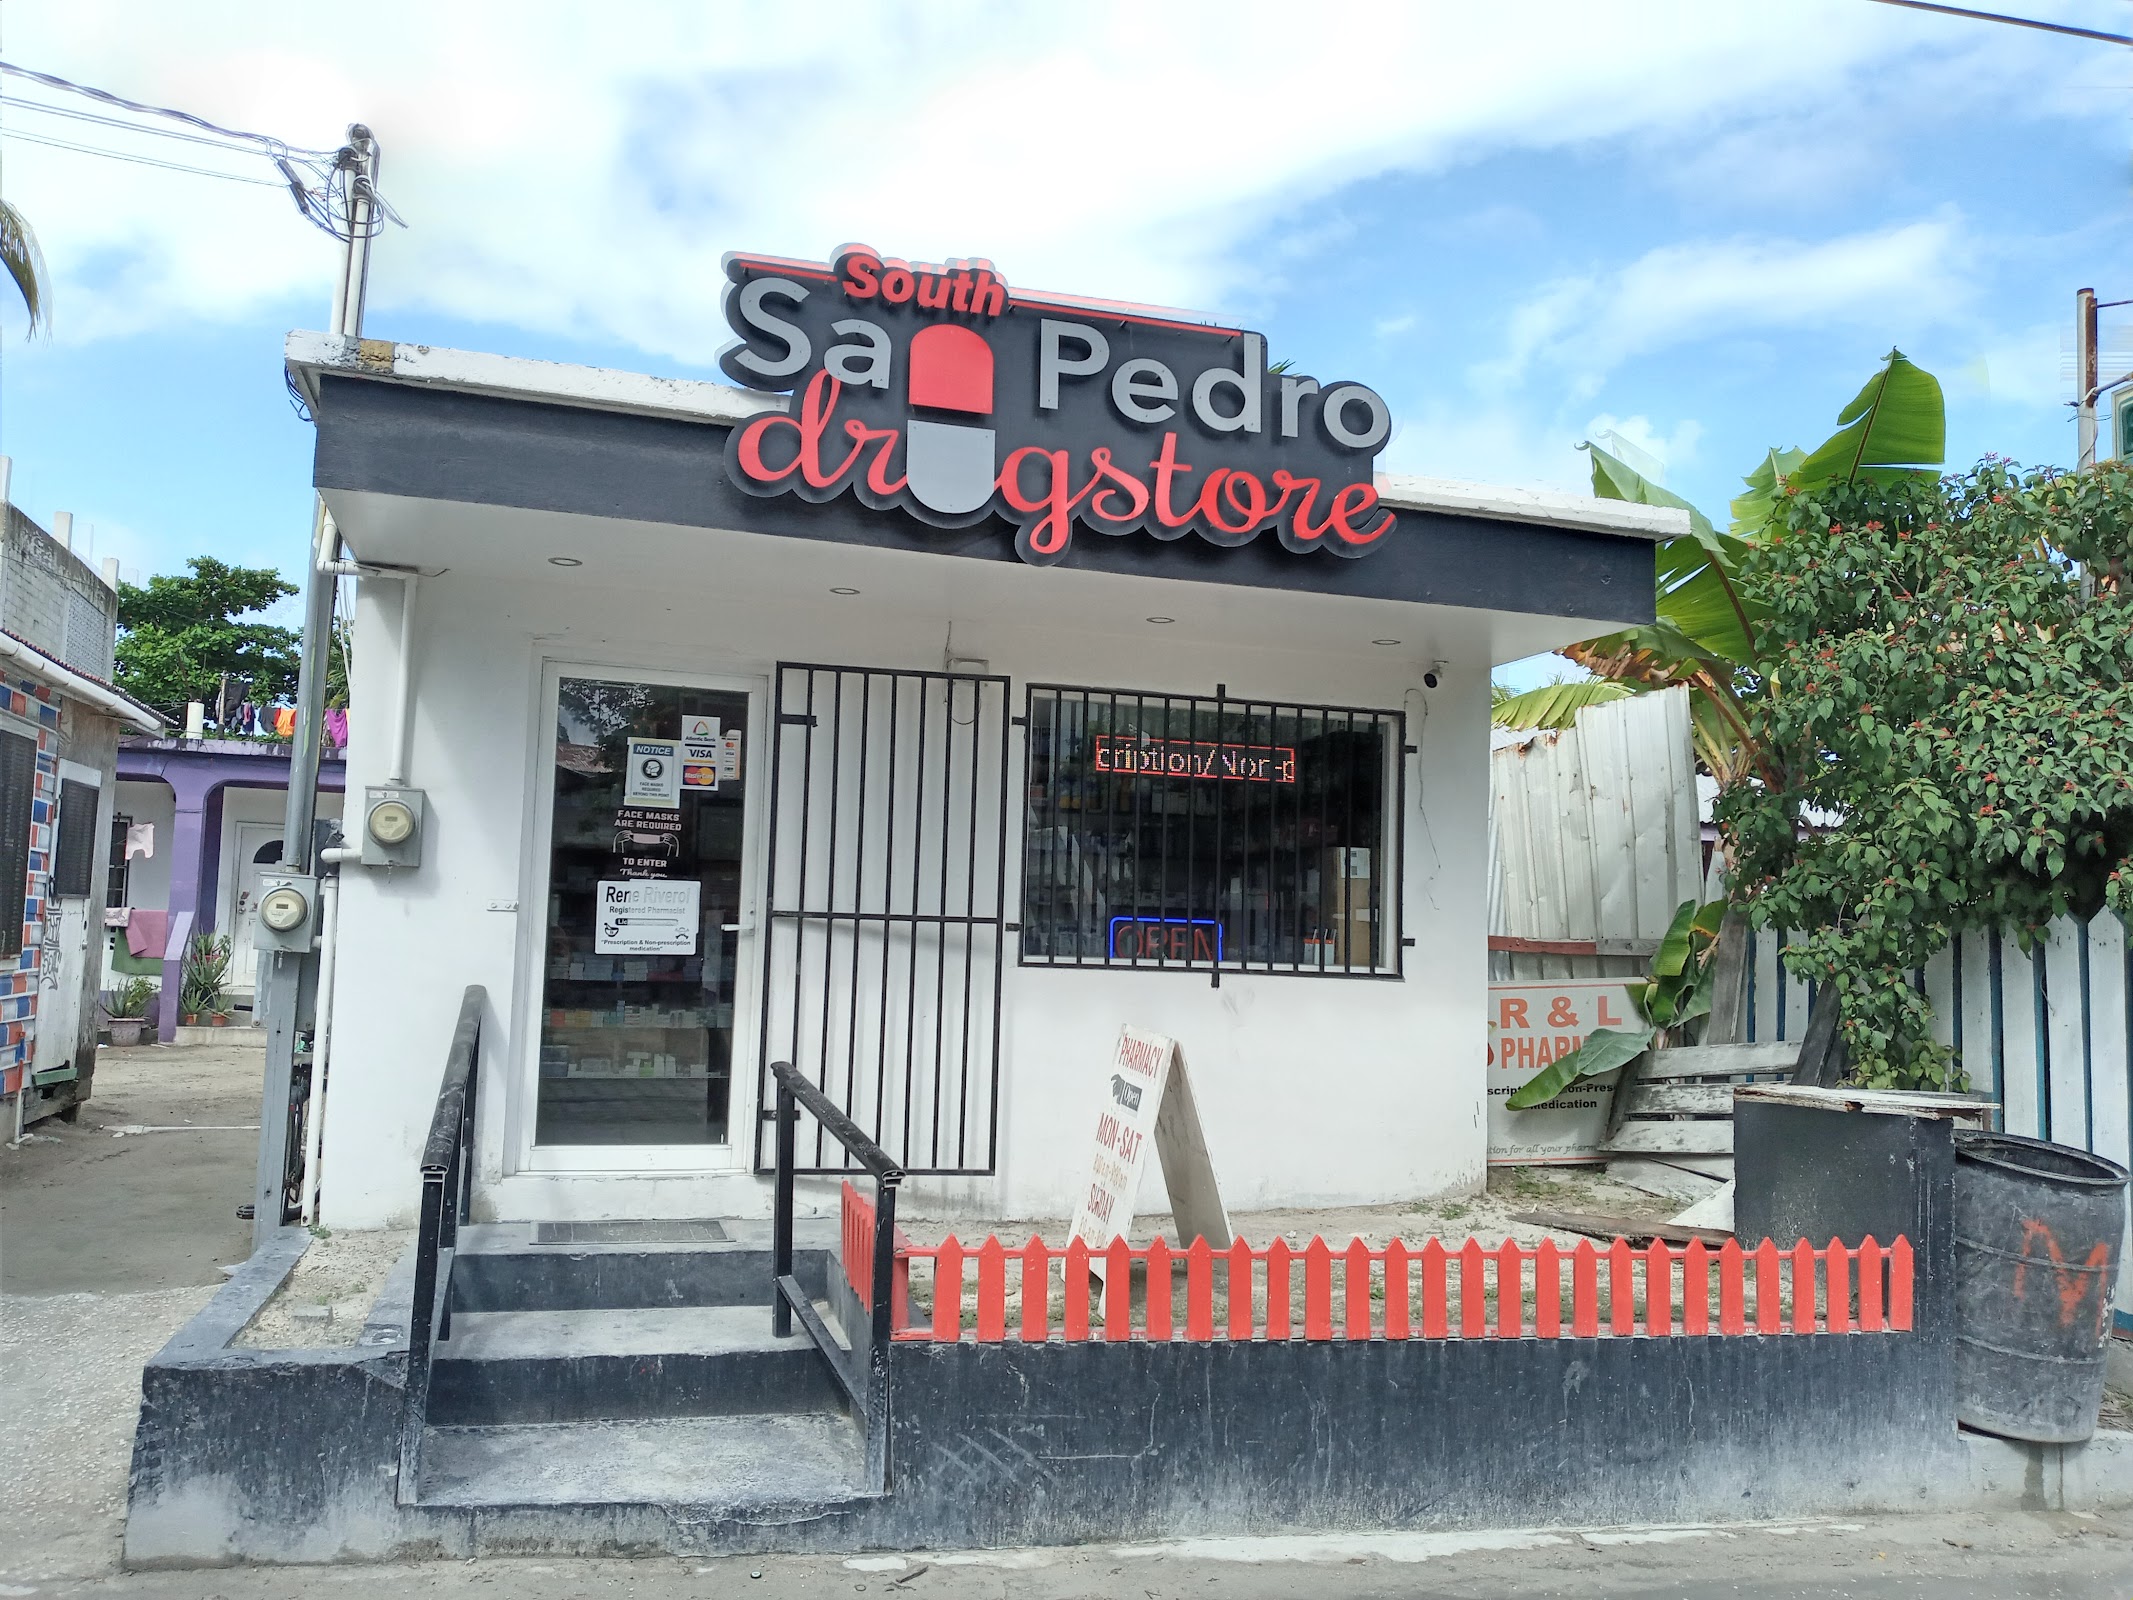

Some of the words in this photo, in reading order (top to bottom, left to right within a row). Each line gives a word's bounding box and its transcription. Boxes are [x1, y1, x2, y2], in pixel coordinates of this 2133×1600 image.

[842, 253, 1005, 317] South
[1037, 317, 1392, 450] Pedro
[636, 745, 672, 756] NOTICE
[688, 749, 713, 759] VISA
[685, 772, 714, 780] MasterCard
[617, 810, 643, 819] FACE
[646, 812, 680, 822] MASKS
[614, 820, 634, 828] ARE
[636, 821, 682, 831] REQUIRED
[622, 857, 635, 866] TO
[638, 858, 667, 867] ENTER
[620, 868, 649, 878] Thank
[606, 886, 639, 904] Rene
[643, 887, 691, 905] Riverol
[609, 906, 646, 916] Registered
[647, 906, 686, 916] Pharmacist
[645, 939, 691, 947] Non-prescription
[1116, 925, 1215, 960] OPEN
[1500, 998, 1530, 1029] R
[1547, 996, 1580, 1028] &
[1597, 995, 1622, 1026] L
[1118, 1035, 1164, 1079] PHARMACY
[1124, 1084, 1140, 1106] Open
[1095, 1112, 1143, 1165] MON-SAT
[1508, 1144, 1525, 1157] for
[1526, 1143, 1541, 1153] all
[1540, 1145, 1563, 1156] your
